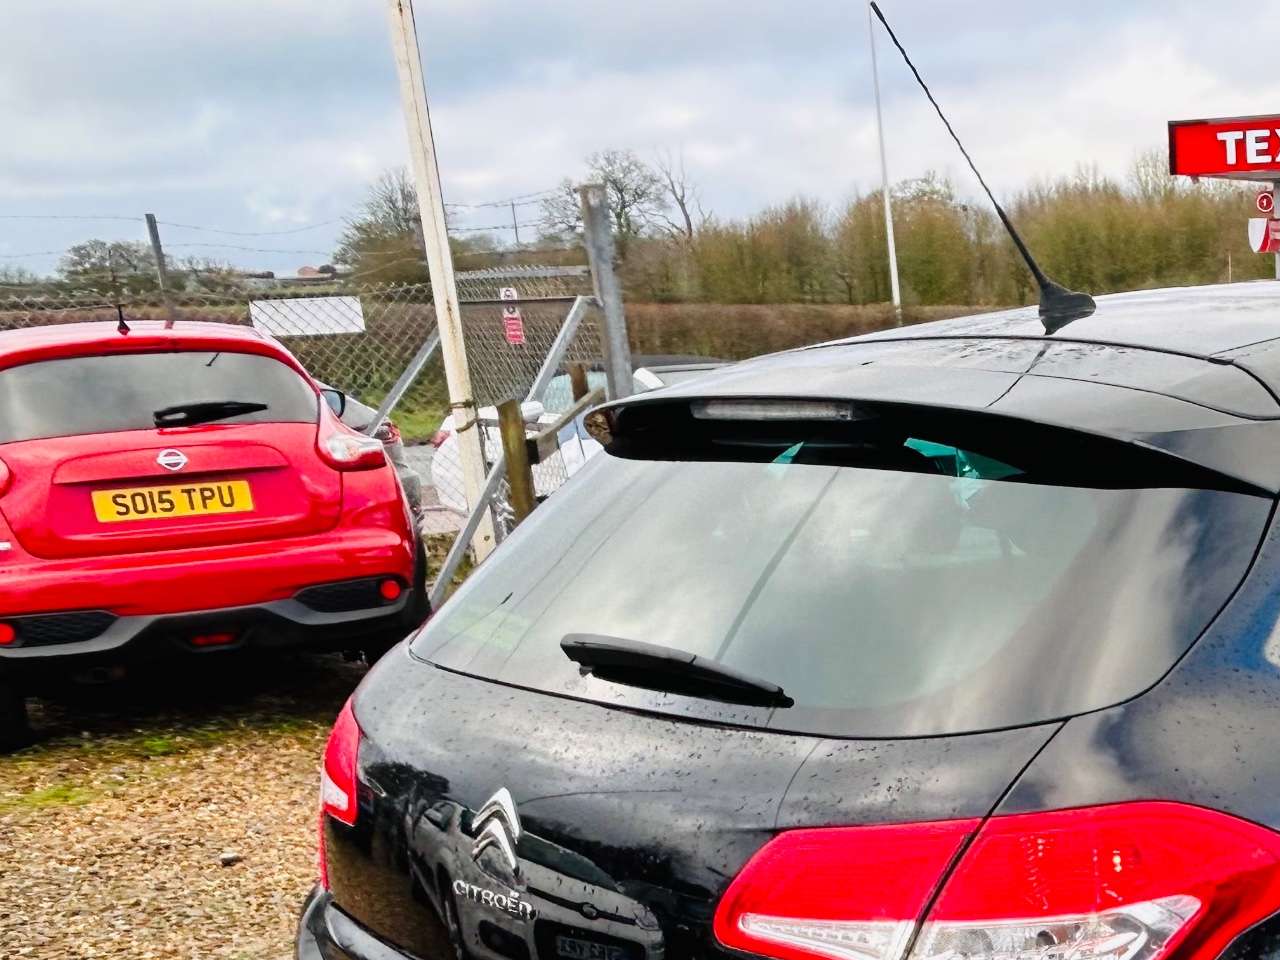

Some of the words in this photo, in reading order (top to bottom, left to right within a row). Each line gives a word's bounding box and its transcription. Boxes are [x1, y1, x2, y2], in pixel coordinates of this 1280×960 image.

[112, 490, 176, 516] SO15
[181, 485, 235, 511] TPU
[452, 879, 536, 921] CITROËN
